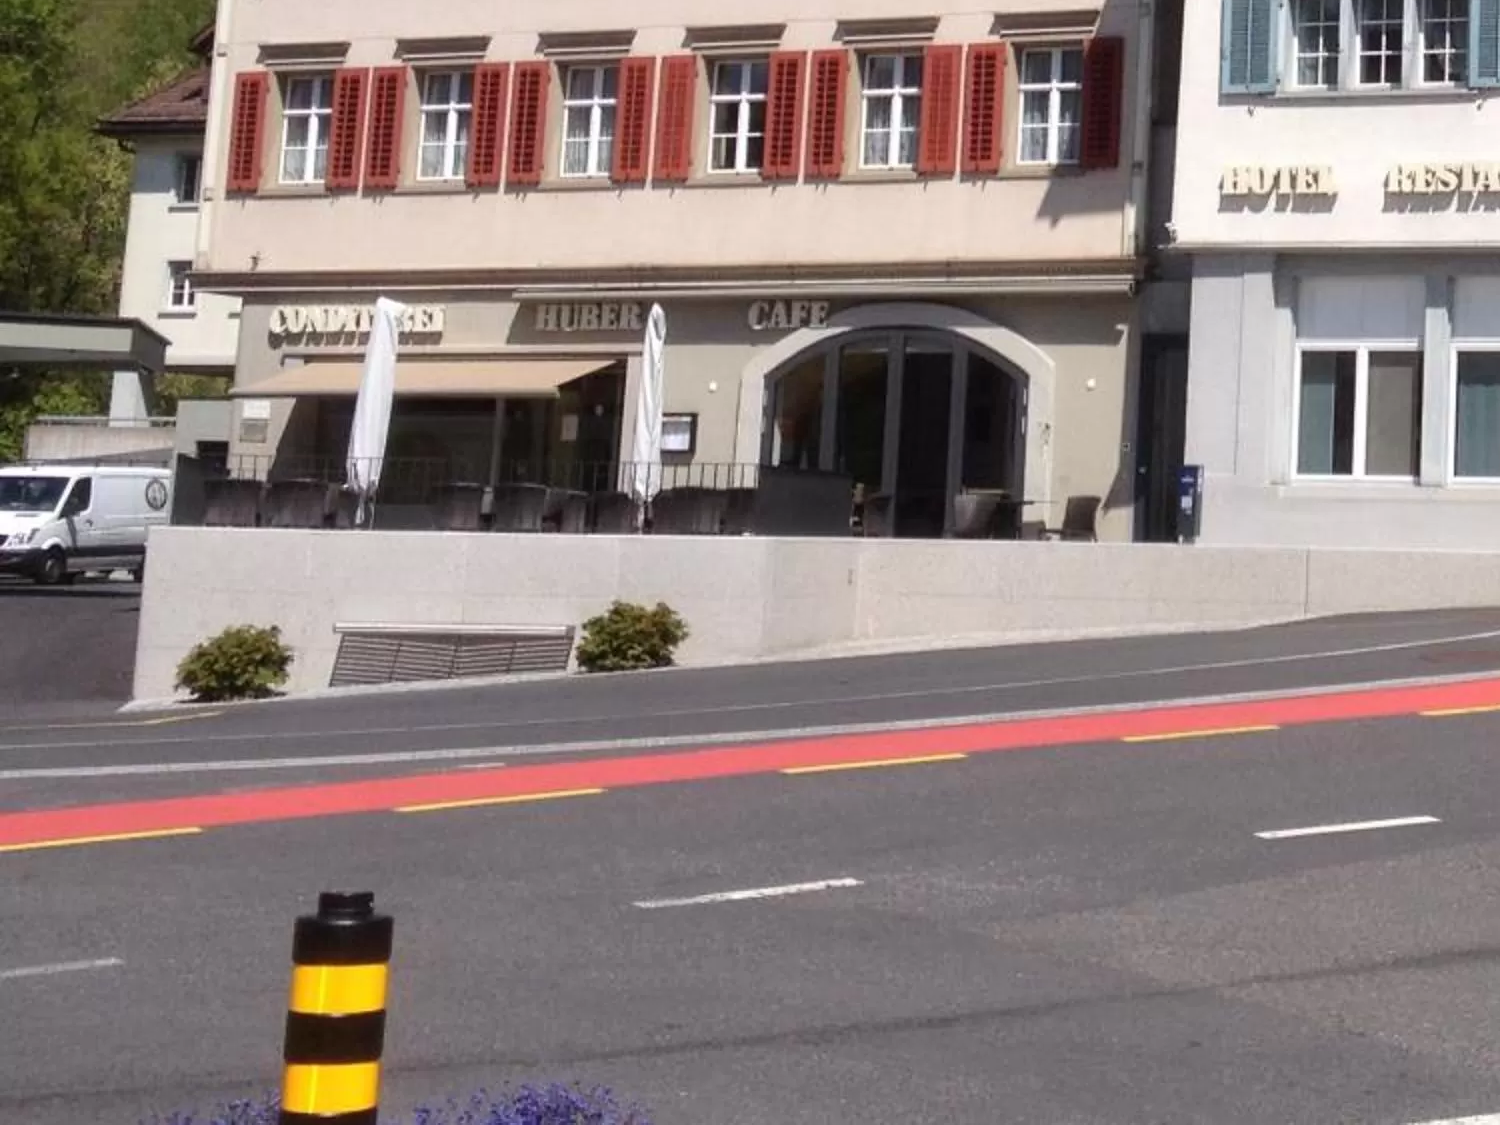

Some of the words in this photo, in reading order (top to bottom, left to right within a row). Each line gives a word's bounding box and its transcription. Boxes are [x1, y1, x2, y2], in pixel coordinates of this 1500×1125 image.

[1220, 163, 1337, 195] HOTEL
[535, 302, 643, 331] HUBER
[749, 300, 830, 330] CAFE
